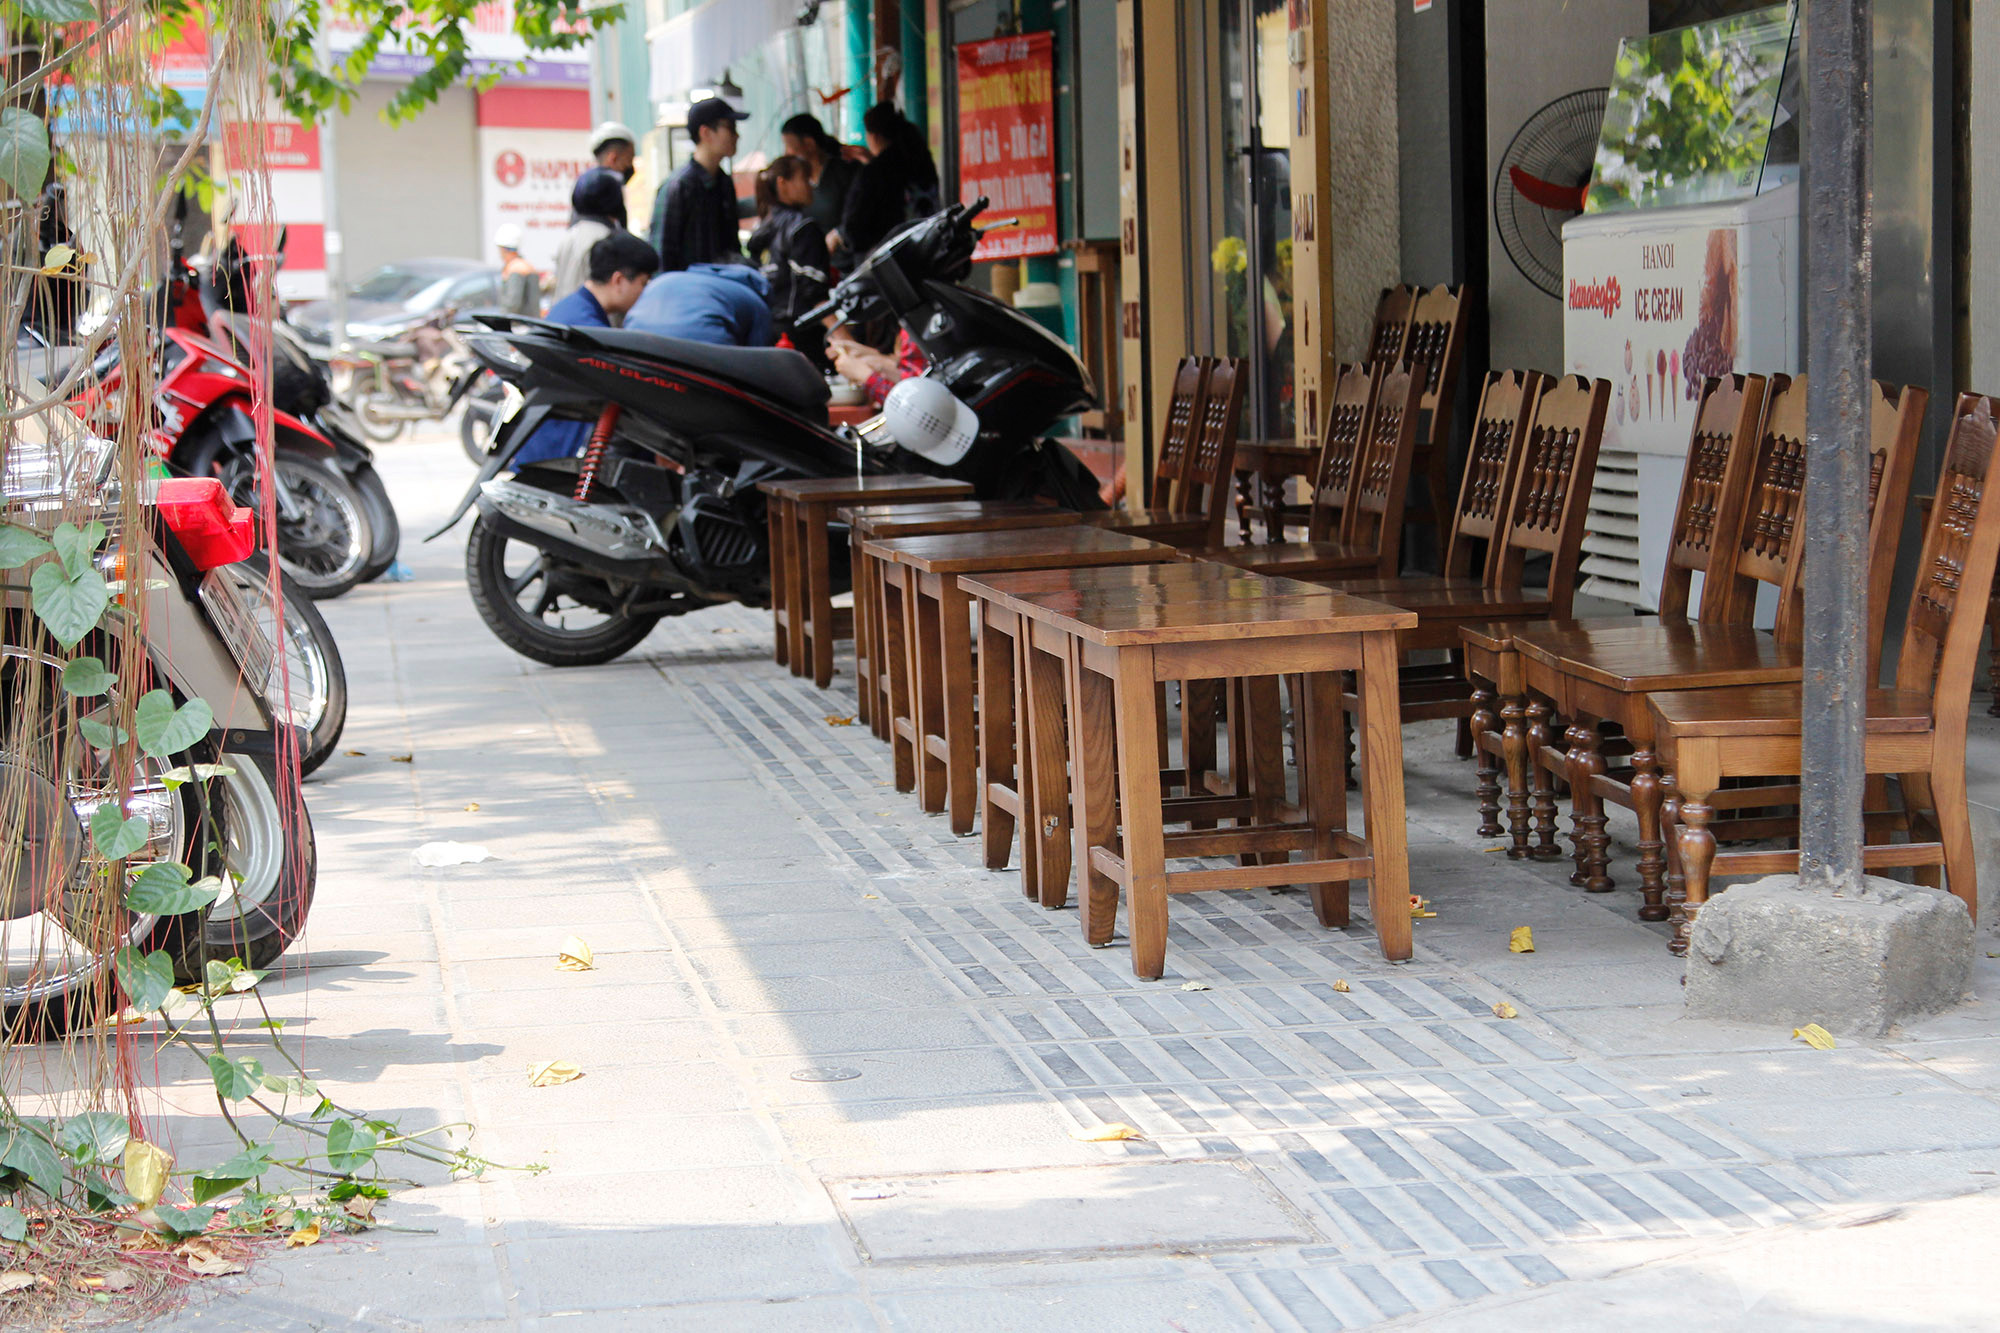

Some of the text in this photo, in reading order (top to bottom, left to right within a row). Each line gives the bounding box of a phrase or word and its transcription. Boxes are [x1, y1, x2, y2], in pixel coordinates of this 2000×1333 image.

[1643, 243, 1675, 270] HANOI
[1568, 275, 1621, 319] Hanoicoffe
[1634, 286, 1683, 323] ICE CREAM
[577, 357, 688, 393] AIR BLADE
